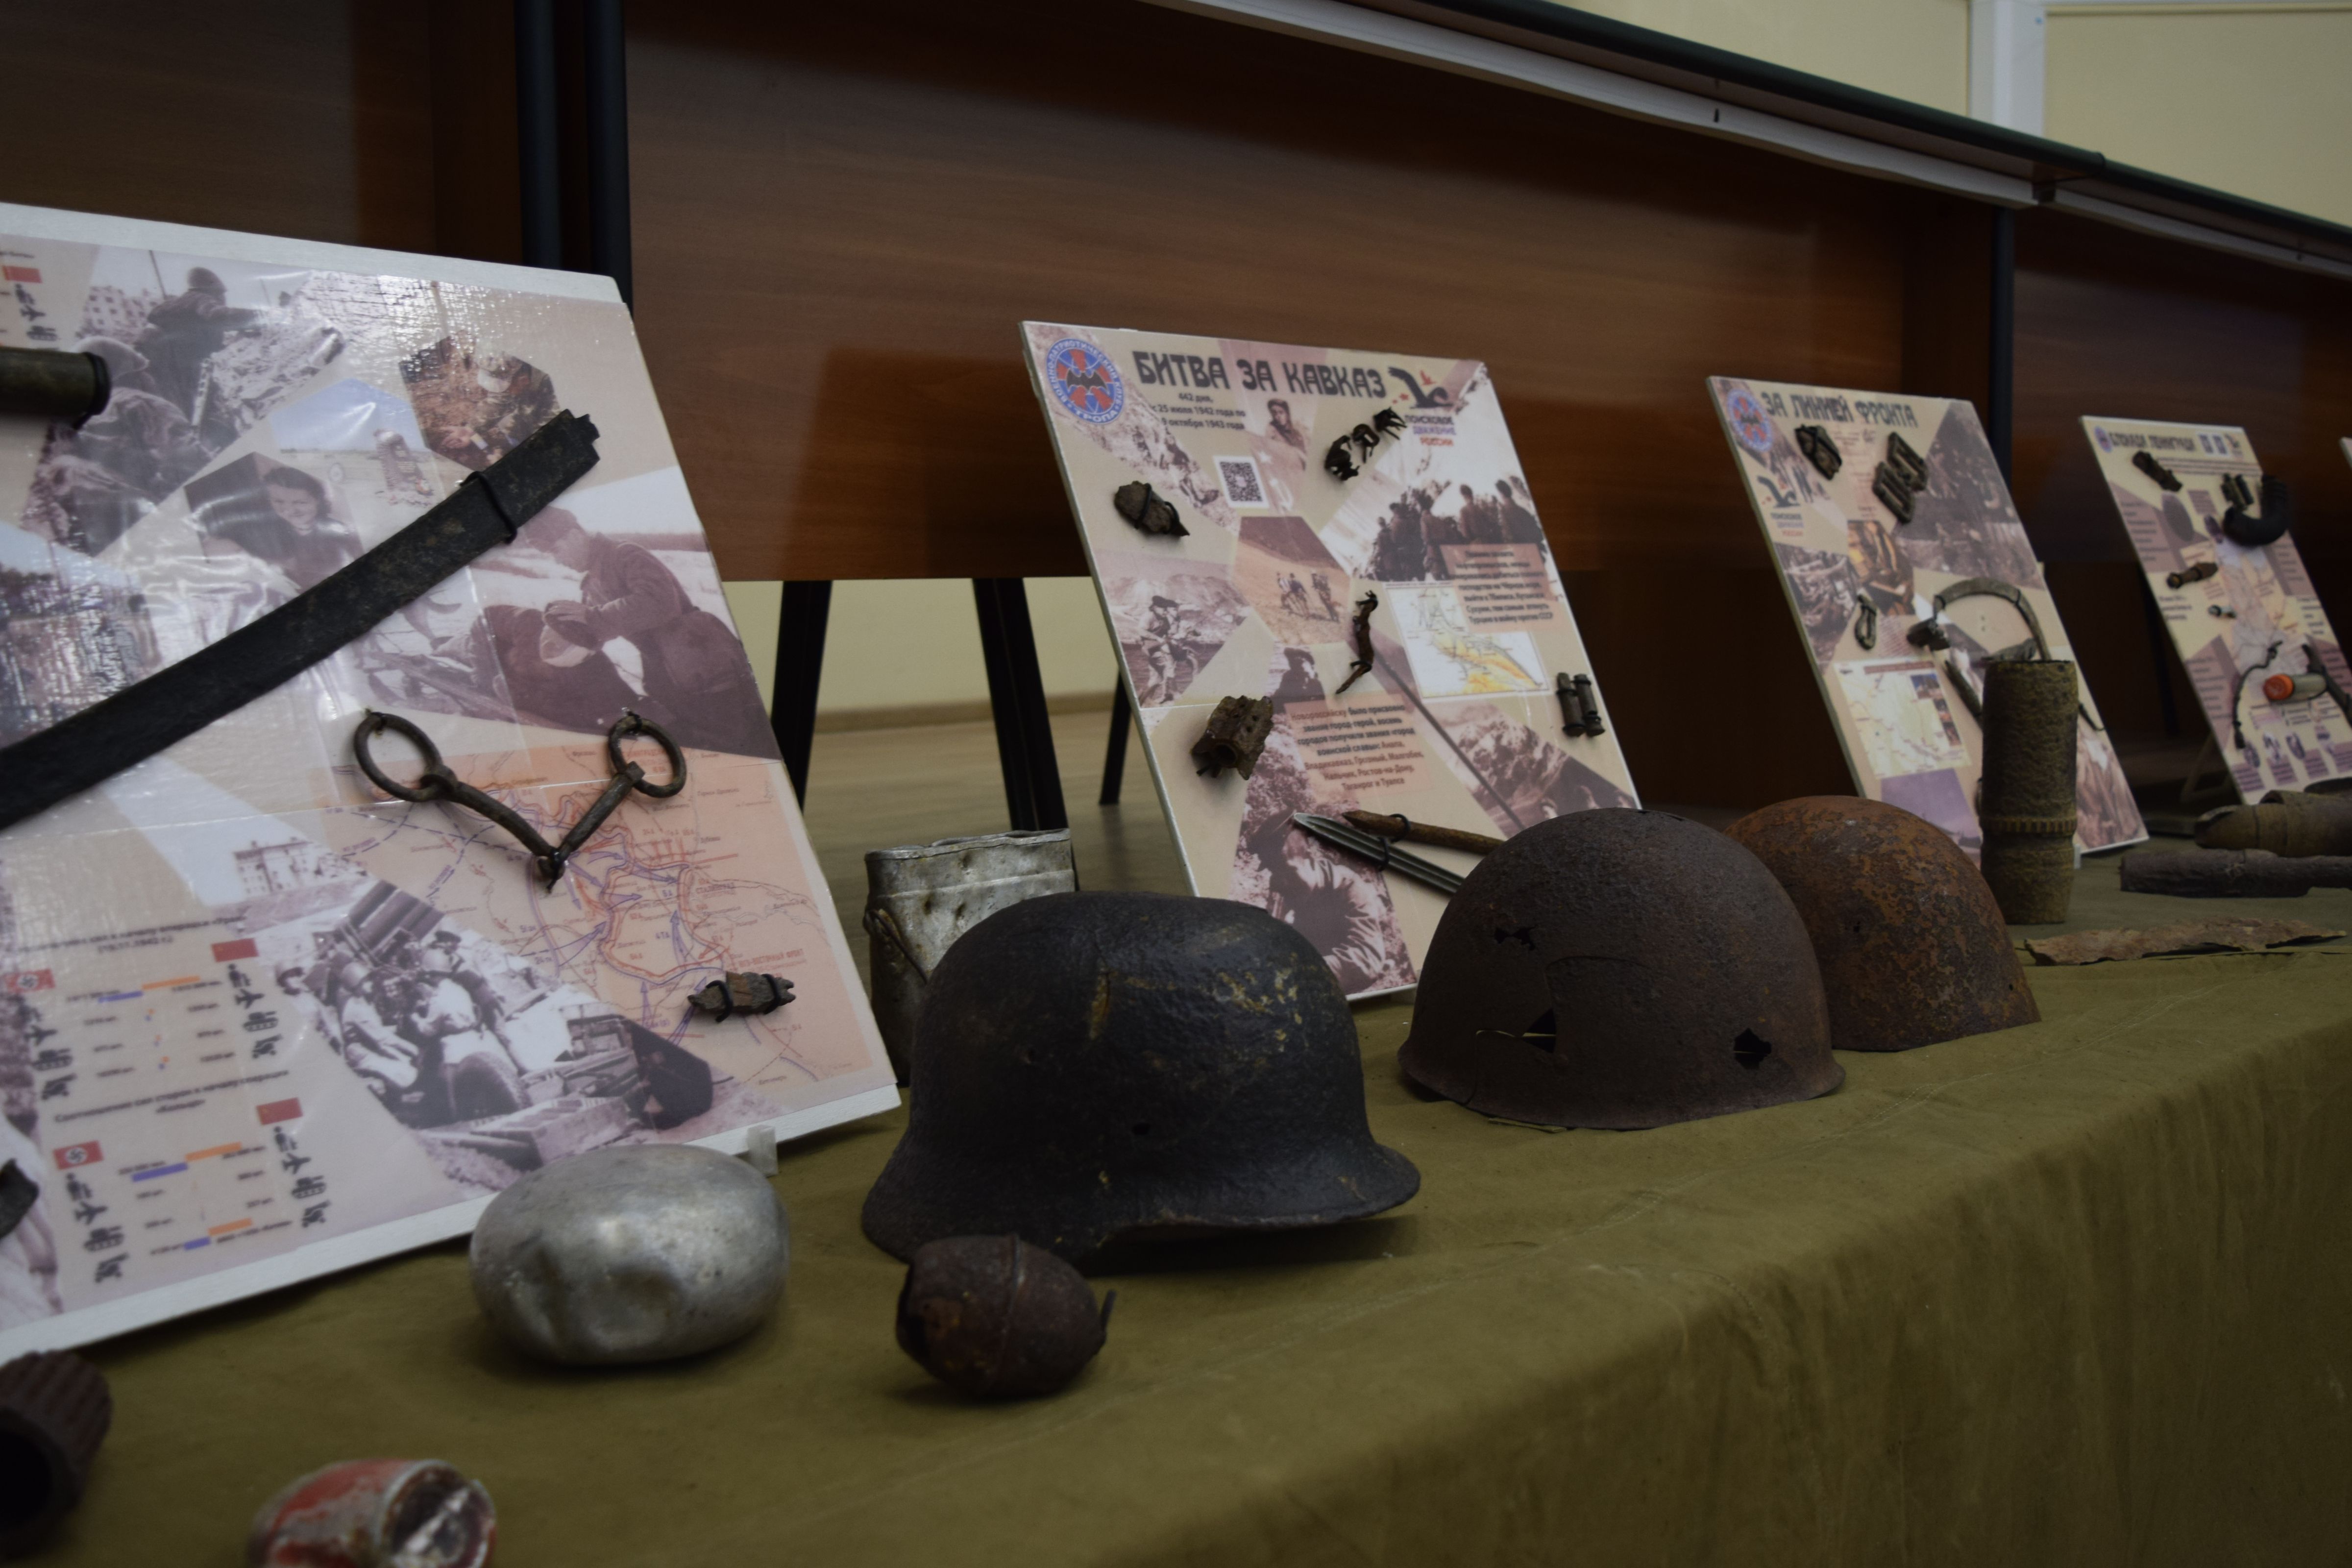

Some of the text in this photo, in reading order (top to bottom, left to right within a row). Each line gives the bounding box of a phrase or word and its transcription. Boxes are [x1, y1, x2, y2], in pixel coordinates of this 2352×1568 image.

[1132, 350, 1387, 398] БИТВА ЗА КАВКАЗ
[1178, 392, 1193, 401] 442
[1159, 404, 1169, 413] 25
[1194, 406, 1214, 416] 1942
[1761, 392, 1788, 417] ЗА
[1855, 400, 1918, 428] ФРОНТА
[1169, 418, 1203, 428] октября
[1205, 420, 1225, 428] 1943
